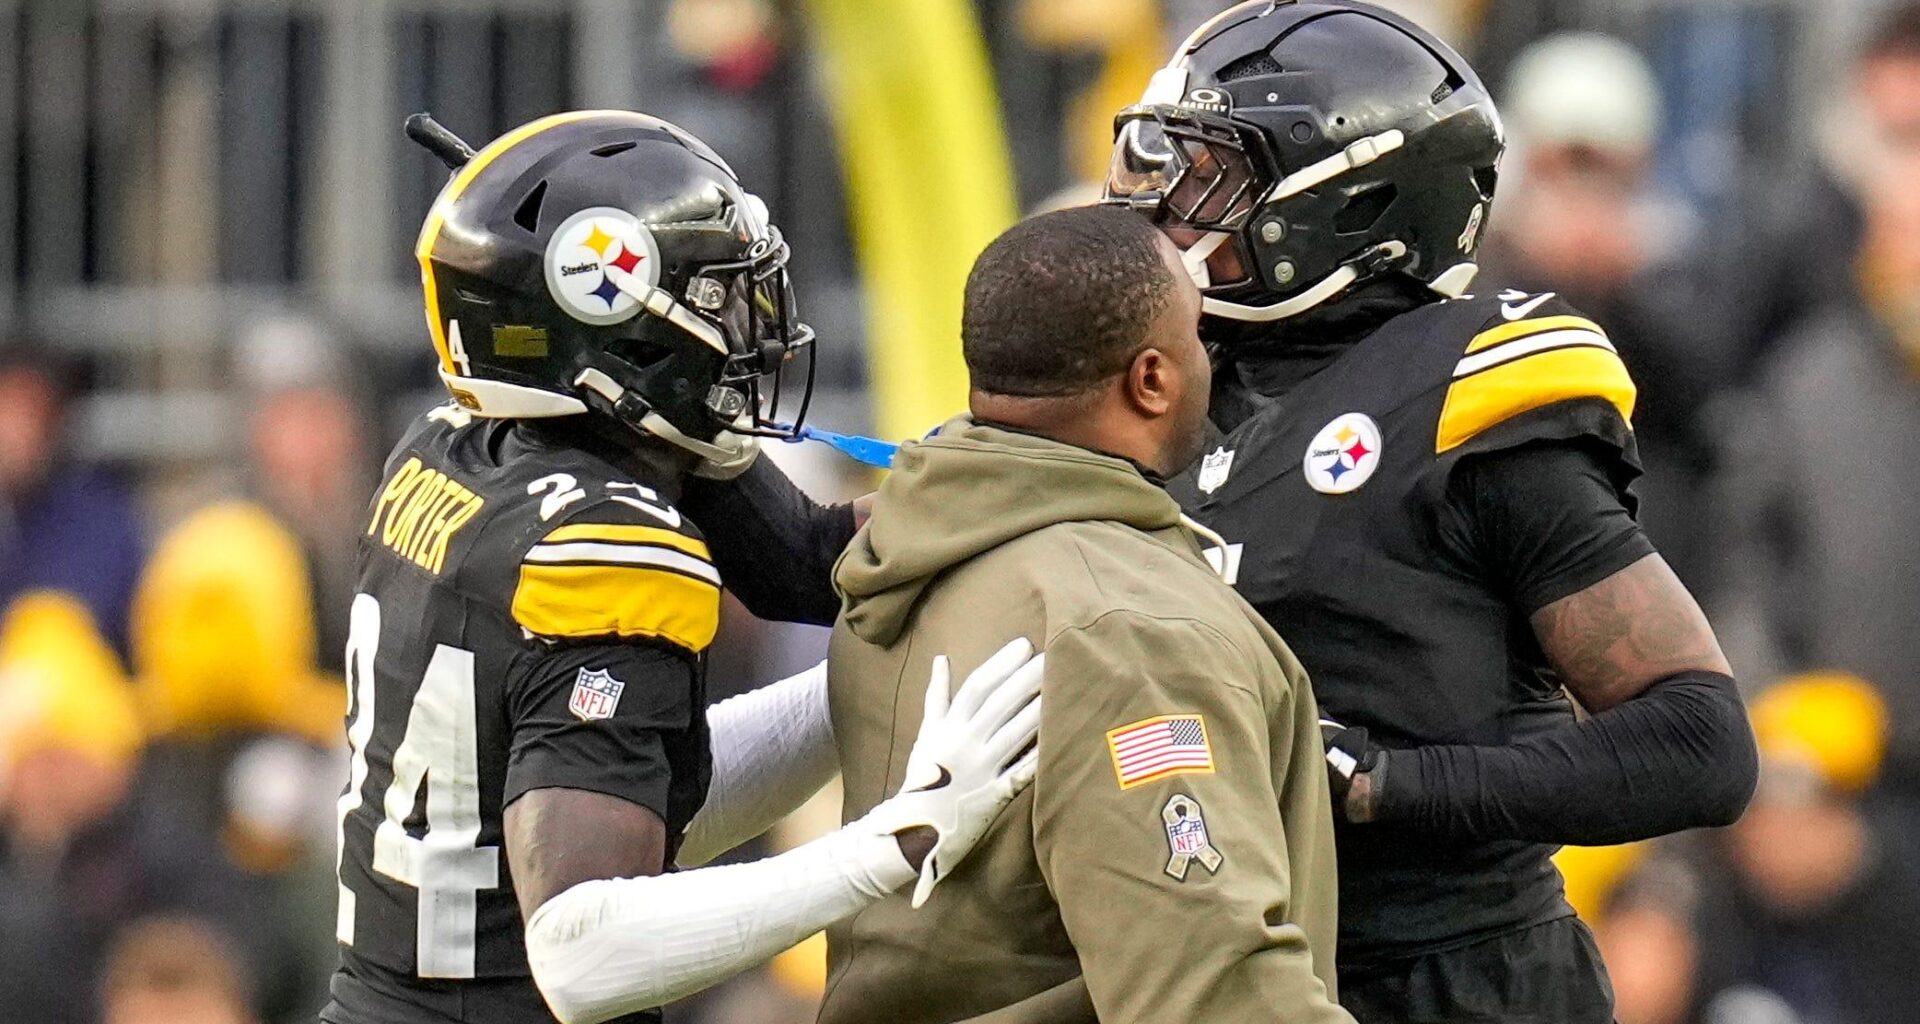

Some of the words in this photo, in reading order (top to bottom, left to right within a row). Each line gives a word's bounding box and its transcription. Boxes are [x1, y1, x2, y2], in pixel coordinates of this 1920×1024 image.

[561, 262, 599, 277] Steelers
[449, 319, 472, 377] 4
[367, 457, 484, 575] PORTER
[575, 689, 607, 715] NFL
[1175, 833, 1203, 851] NFL
